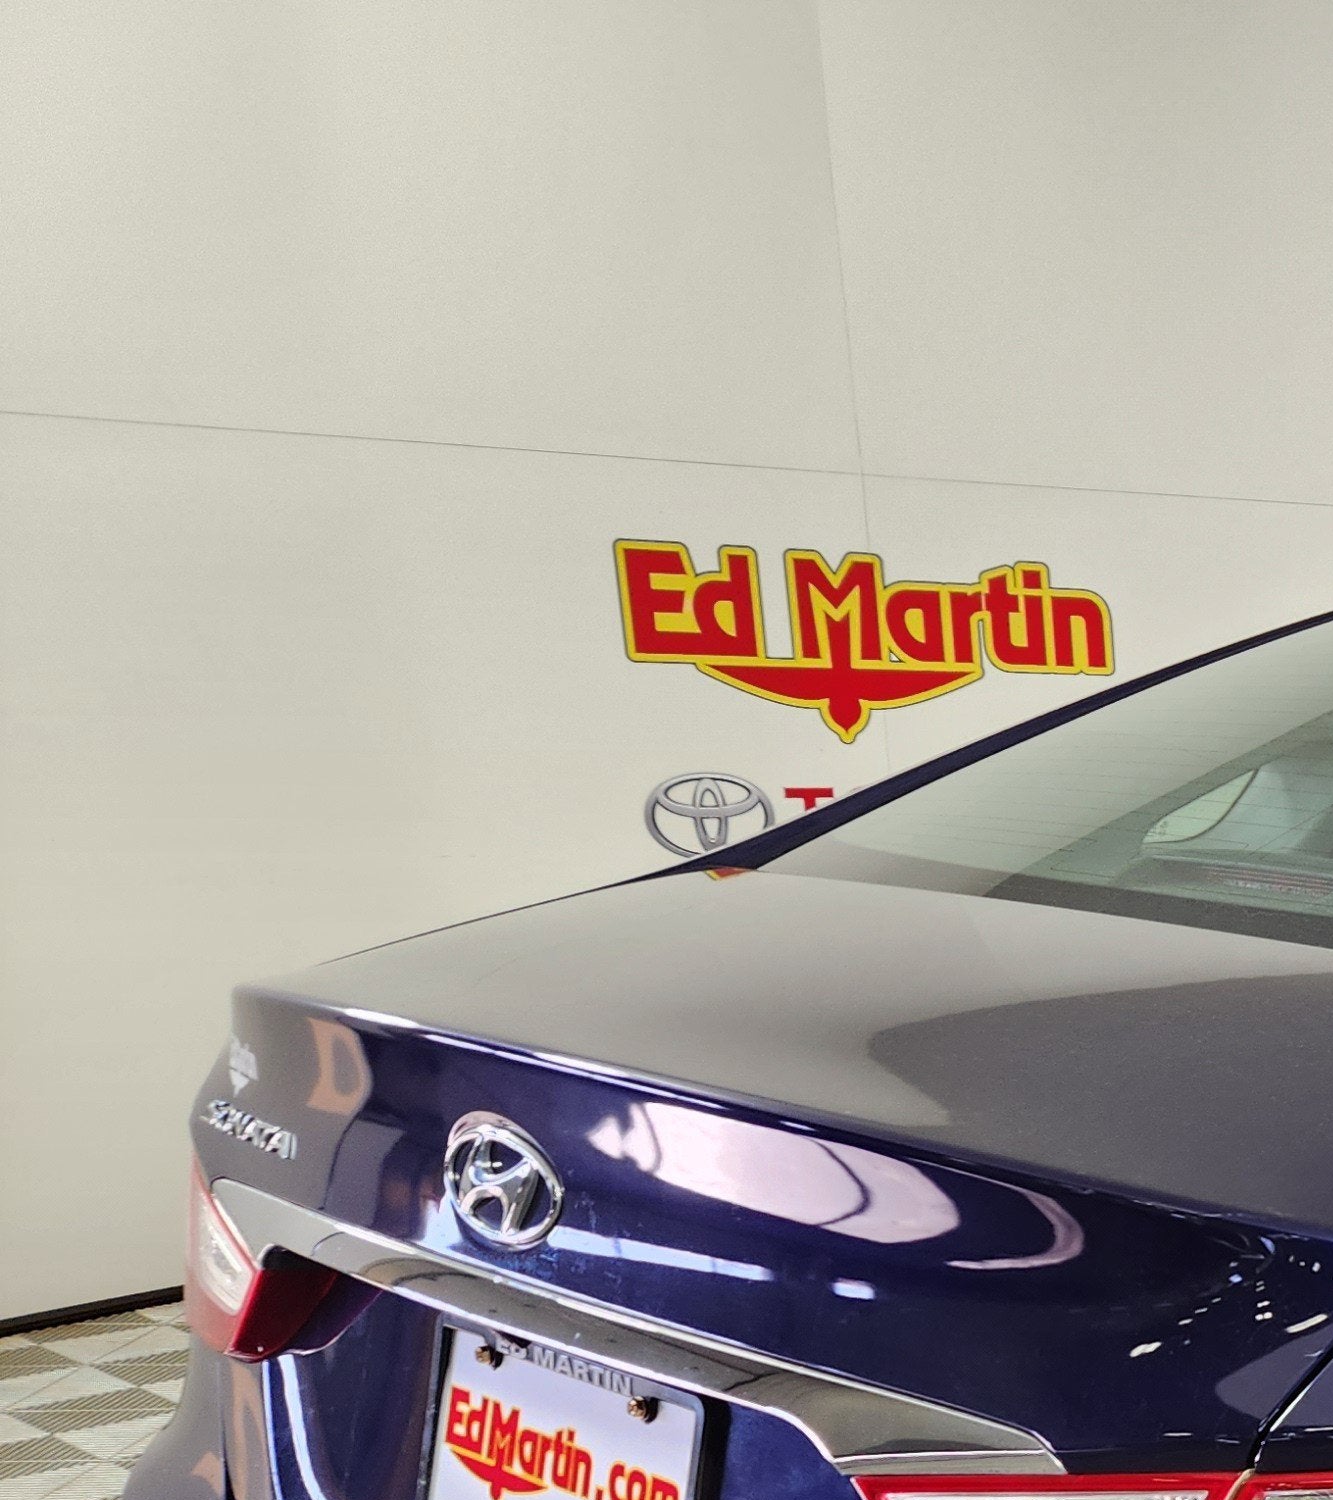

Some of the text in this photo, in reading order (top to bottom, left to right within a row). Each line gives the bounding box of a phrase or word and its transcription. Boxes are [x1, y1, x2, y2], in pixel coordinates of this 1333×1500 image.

[614, 539, 1115, 676] Ed Martin
[204, 1099, 297, 1160] SONATA
[533, 1346, 633, 1397] MARTIN
